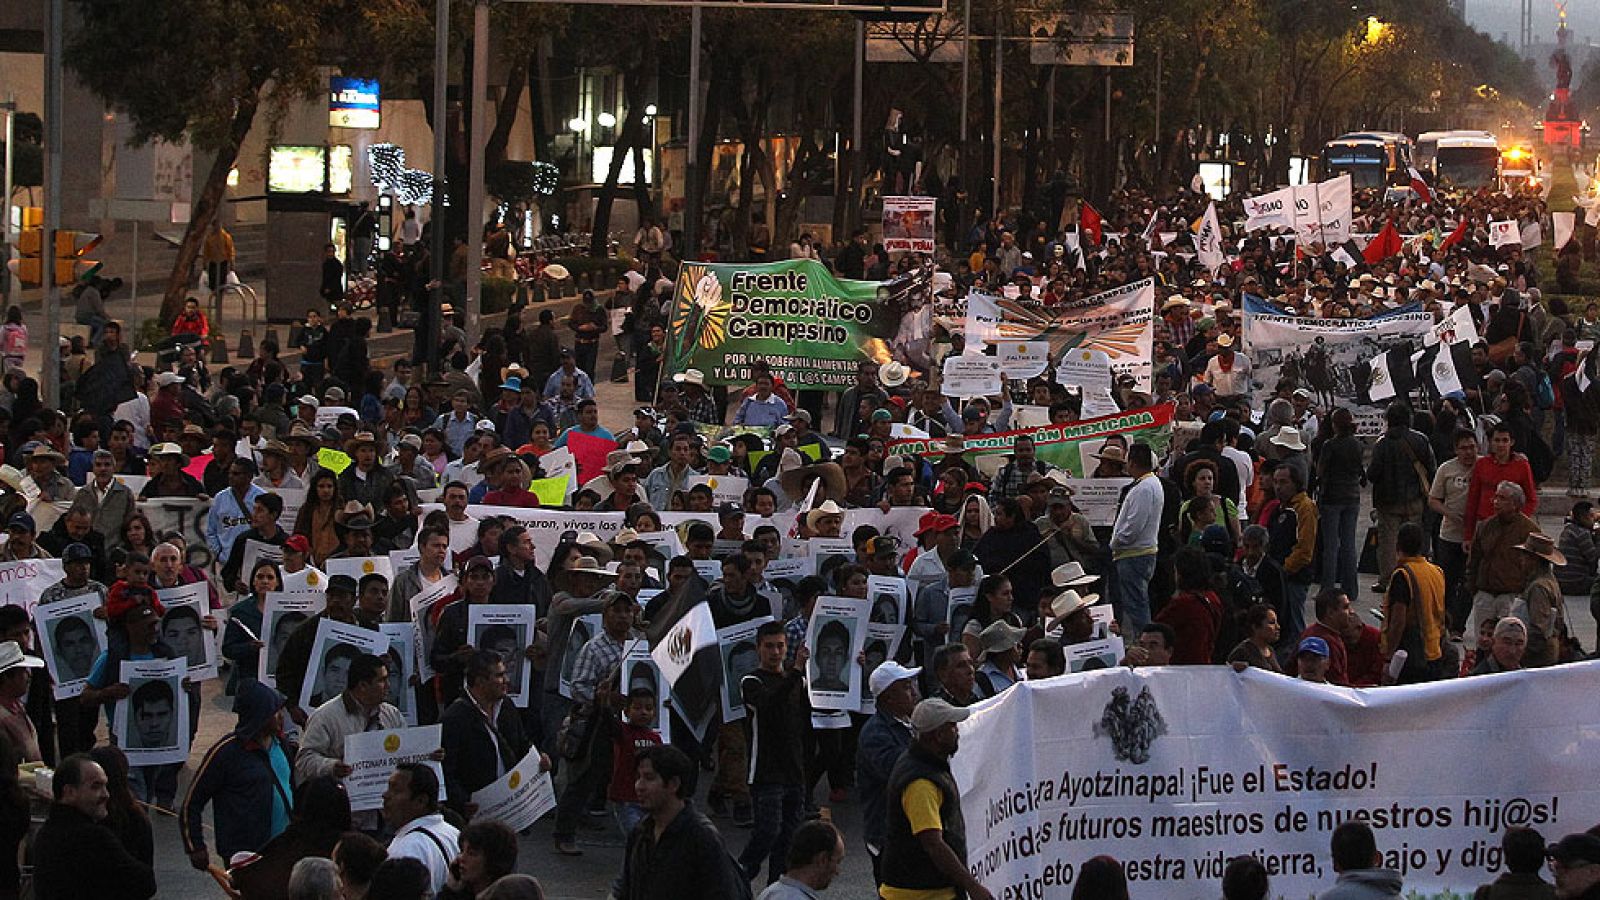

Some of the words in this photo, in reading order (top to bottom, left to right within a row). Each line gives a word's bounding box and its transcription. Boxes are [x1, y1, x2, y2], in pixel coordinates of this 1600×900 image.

[731, 270, 807, 292] Frente
[730, 292, 871, 323] Democrático
[729, 317, 847, 345] Campesino
[724, 353, 747, 365] POR
[714, 367, 721, 378] Y
[724, 368, 737, 380] LA
[822, 373, 859, 386] CAMPES
[889, 441, 925, 455] VIVA
[1064, 411, 1154, 438] MEXICANA
[564, 519, 596, 530] vivos
[598, 519, 617, 530] los
[1057, 768, 1184, 806] Ayotzinapa!
[1191, 765, 1234, 802] ¡Fue
[1242, 764, 1265, 793] el
[1272, 762, 1377, 792] Estado!
[1058, 812, 1142, 842] futuros
[1151, 808, 1265, 837] maestros
[1274, 804, 1309, 833] de
[1317, 801, 1452, 832] nuestros
[1463, 796, 1559, 833] hij@s!
[1434, 848, 1452, 876] y
[1461, 840, 1503, 873] dig
